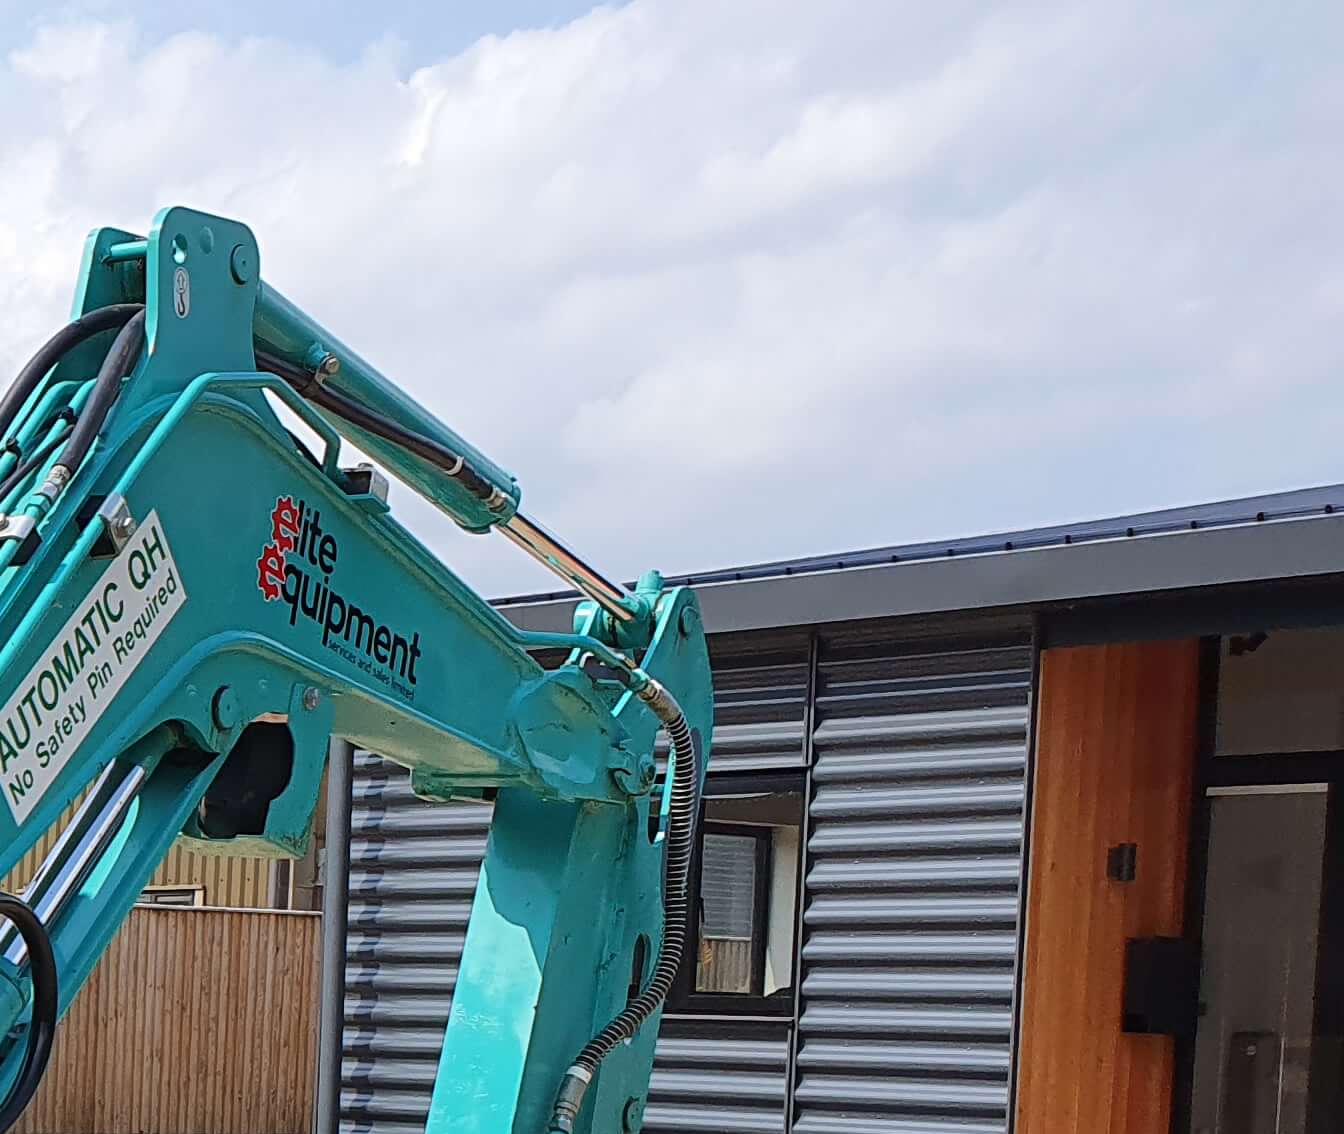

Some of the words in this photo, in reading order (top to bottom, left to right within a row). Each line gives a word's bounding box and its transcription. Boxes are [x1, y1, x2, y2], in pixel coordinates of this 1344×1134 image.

[127, 526, 166, 591] QH
[272, 495, 337, 574] elite
[257, 544, 421, 685] equipment
[8, 771, 34, 806] No
[35, 696, 86, 769] Safety
[86, 662, 113, 700] Pin
[112, 568, 177, 665] Required
